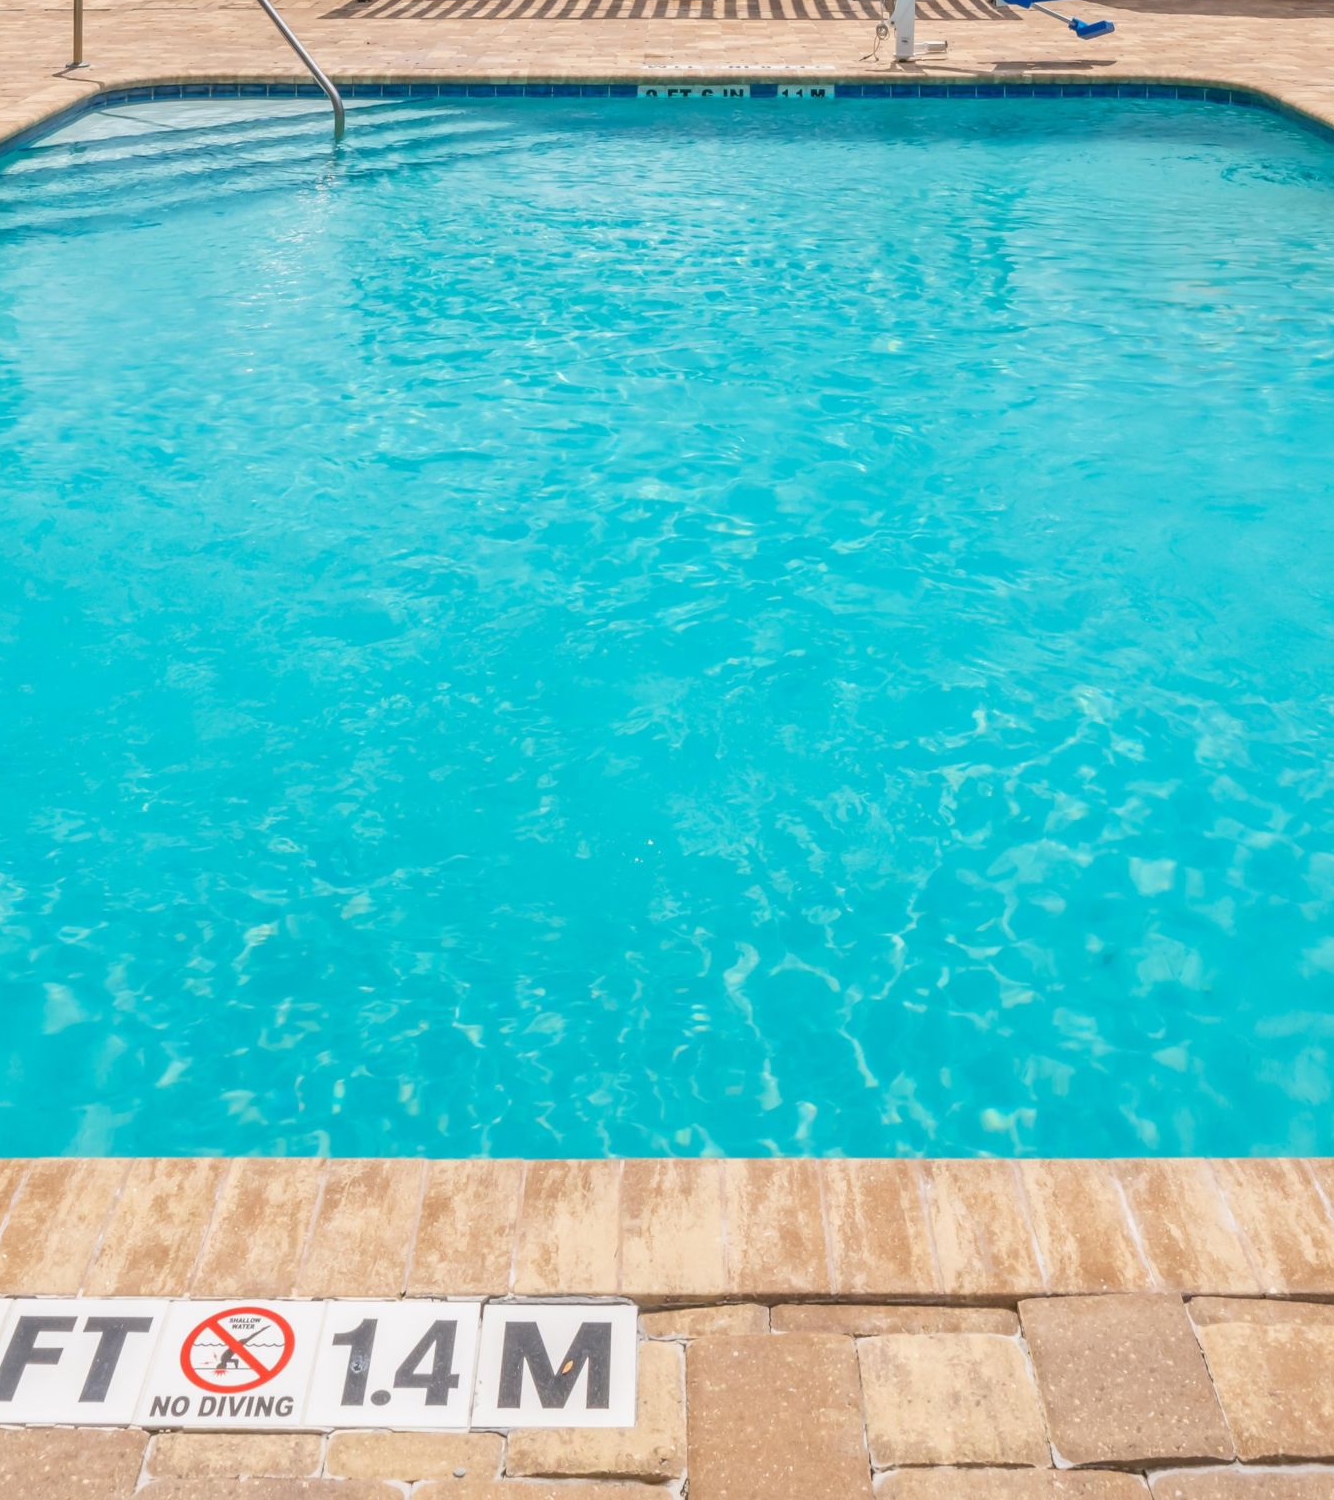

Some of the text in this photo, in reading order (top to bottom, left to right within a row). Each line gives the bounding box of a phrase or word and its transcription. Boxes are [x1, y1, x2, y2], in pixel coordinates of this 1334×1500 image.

[332, 1318, 460, 1406] 1.4
[497, 1321, 612, 1409] M
[149, 1395, 294, 1417] NO DIVING
